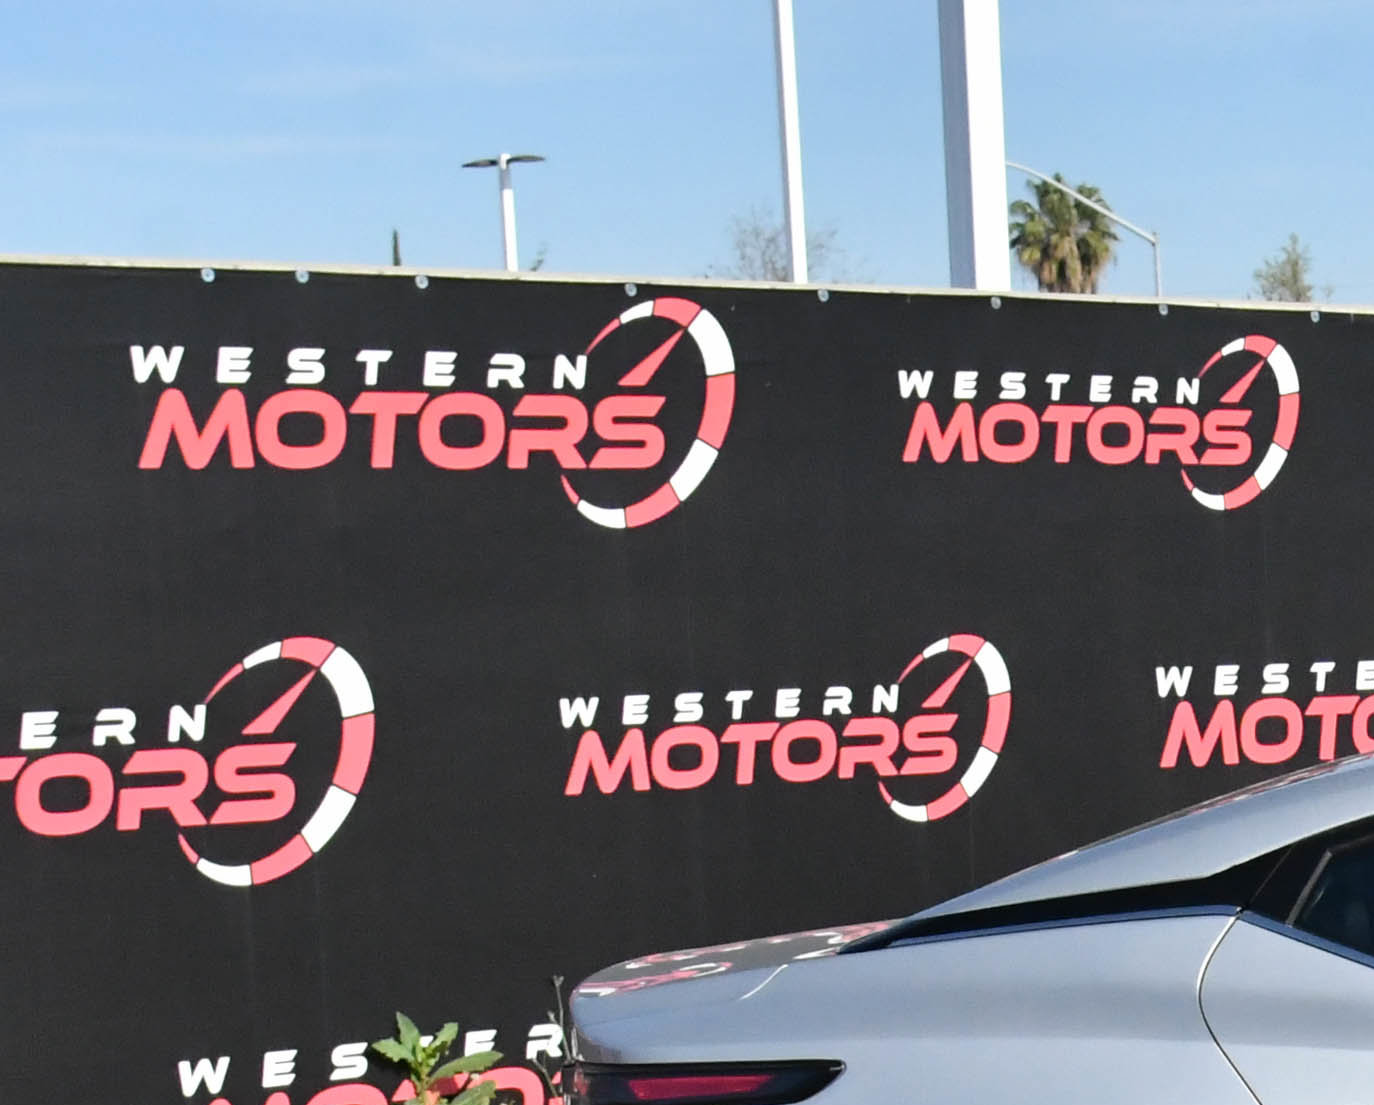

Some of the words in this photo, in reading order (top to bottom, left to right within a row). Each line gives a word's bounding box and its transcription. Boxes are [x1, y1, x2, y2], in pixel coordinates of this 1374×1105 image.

[130, 345, 588, 390] WESTERN
[898, 369, 1201, 405] WESTERN
[138, 387, 667, 471] MOTORS
[902, 401, 1254, 466] MOTORS
[19, 704, 207, 750] ERN
[559, 683, 900, 729] WESTERN
[564, 712, 959, 797] MOTORS
[177, 1023, 565, 1098] WESER
